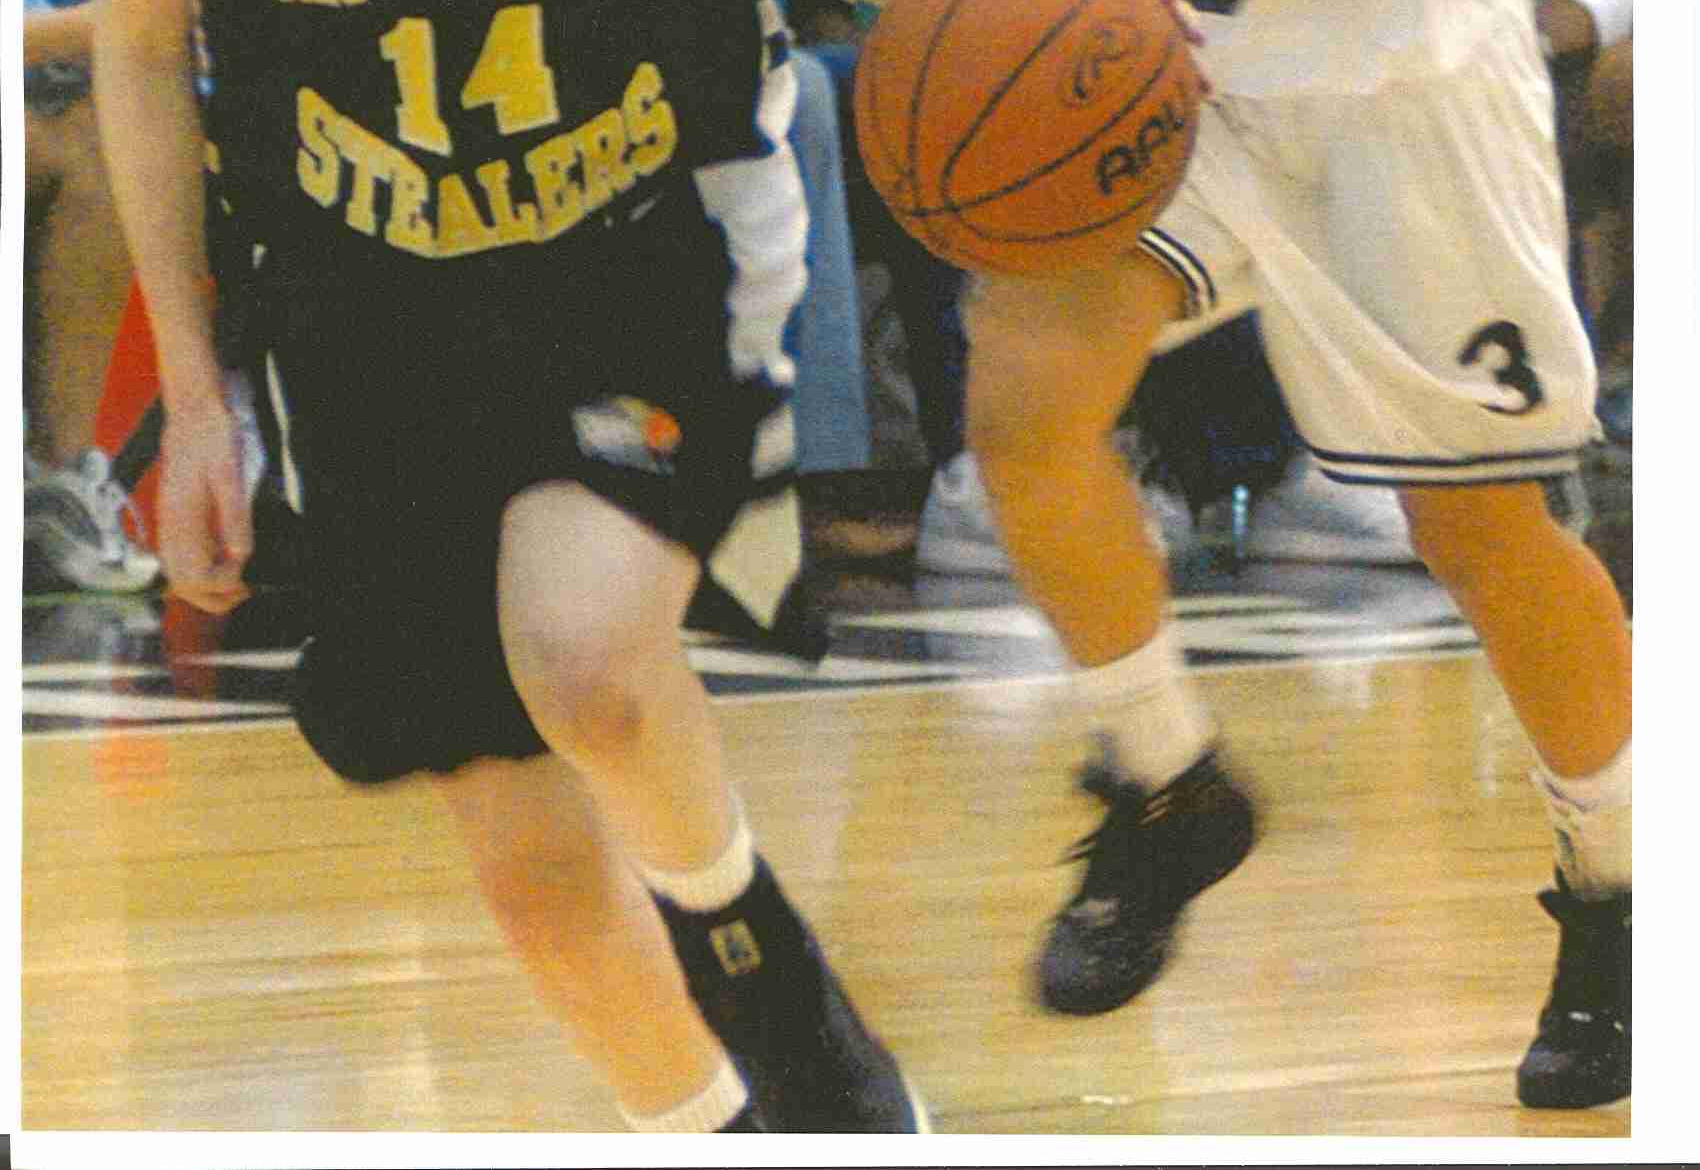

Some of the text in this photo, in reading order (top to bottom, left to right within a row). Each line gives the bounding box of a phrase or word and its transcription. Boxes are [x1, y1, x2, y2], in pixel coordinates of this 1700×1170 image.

[379, 3, 560, 157] 14
[296, 62, 677, 259] STEALERS
[1459, 320, 1544, 415] 3
